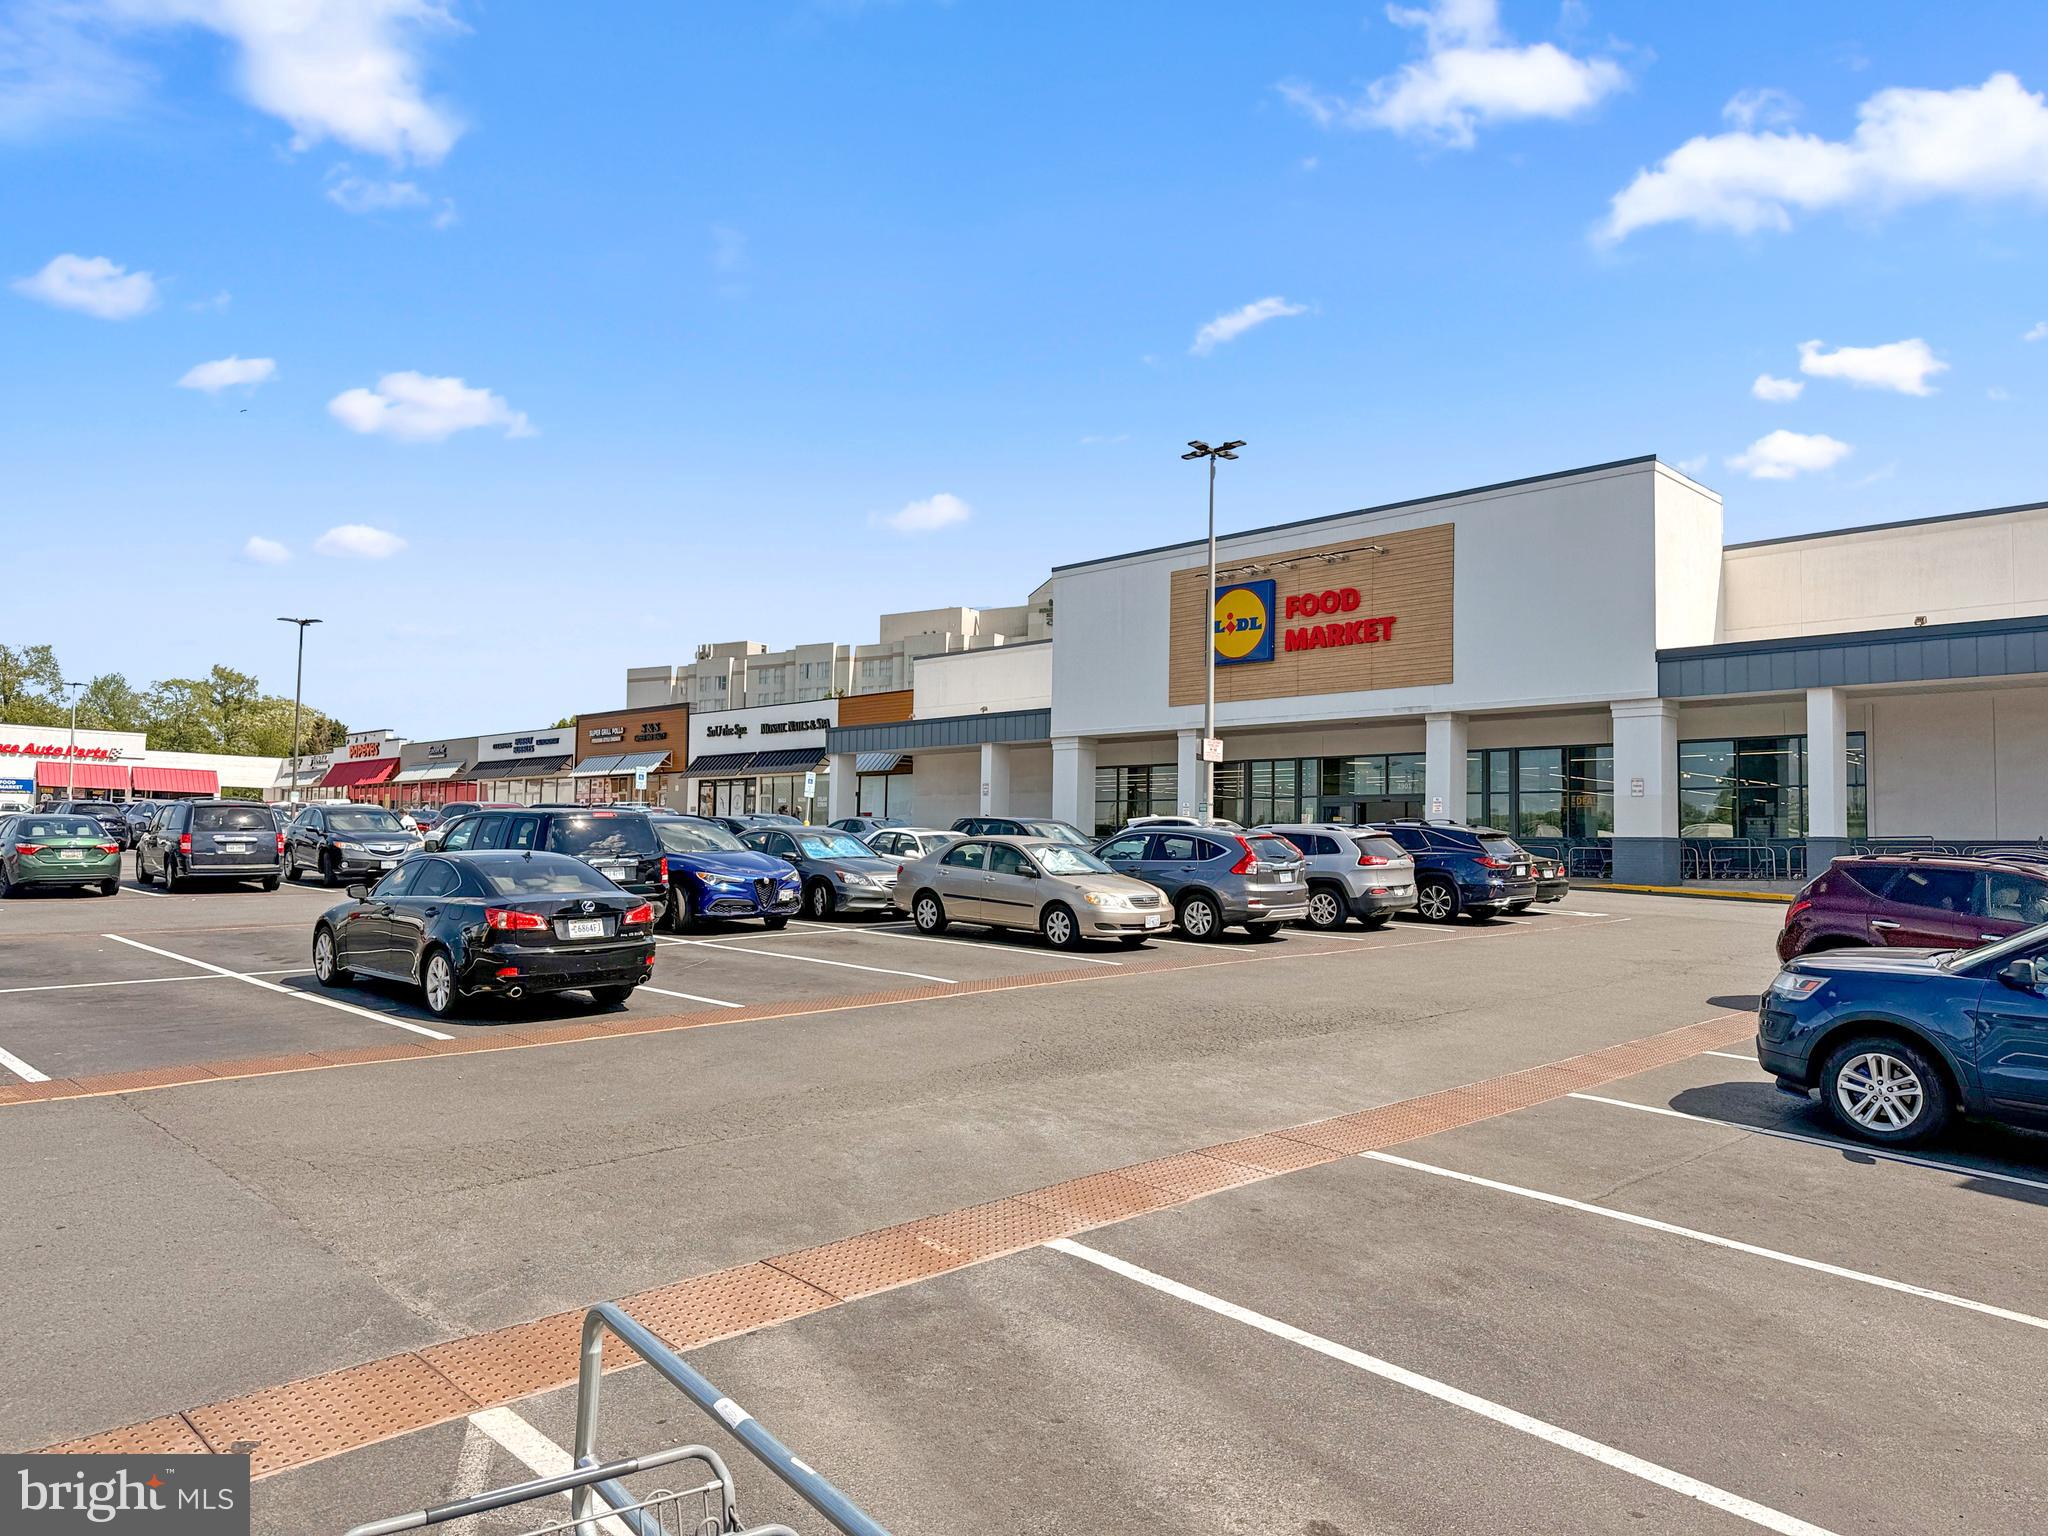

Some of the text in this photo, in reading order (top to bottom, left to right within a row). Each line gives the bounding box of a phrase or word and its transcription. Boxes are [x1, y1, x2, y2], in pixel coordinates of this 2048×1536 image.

[1285, 587, 1361, 618] FOOD
[1284, 615, 1397, 652] MARKET
[22, 742, 64, 757] Auto
[65, 745, 108, 759] Parts
